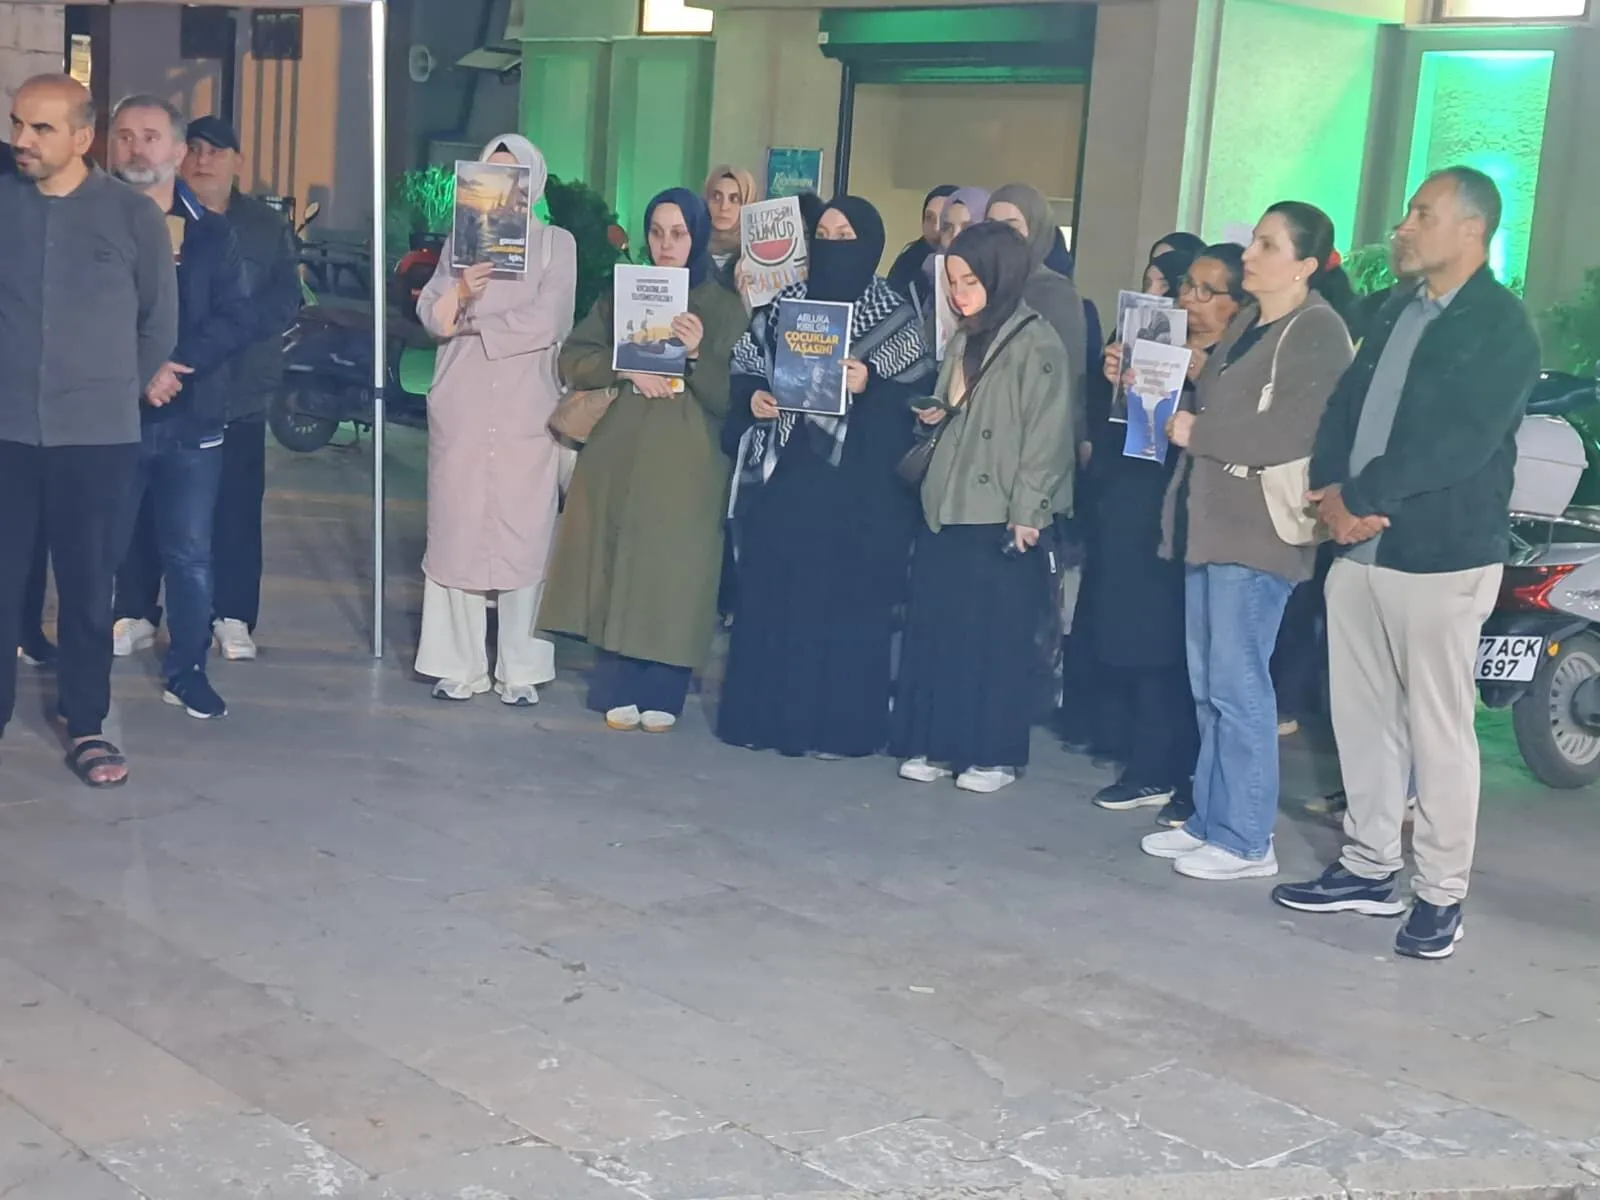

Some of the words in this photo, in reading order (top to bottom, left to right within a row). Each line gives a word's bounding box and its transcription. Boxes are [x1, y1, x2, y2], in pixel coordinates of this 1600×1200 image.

[748, 220, 795, 242] SUMUD
[796, 312, 830, 324] ABLUKA
[1496, 638, 1540, 657] ACK
[1480, 659, 1519, 678] 697
